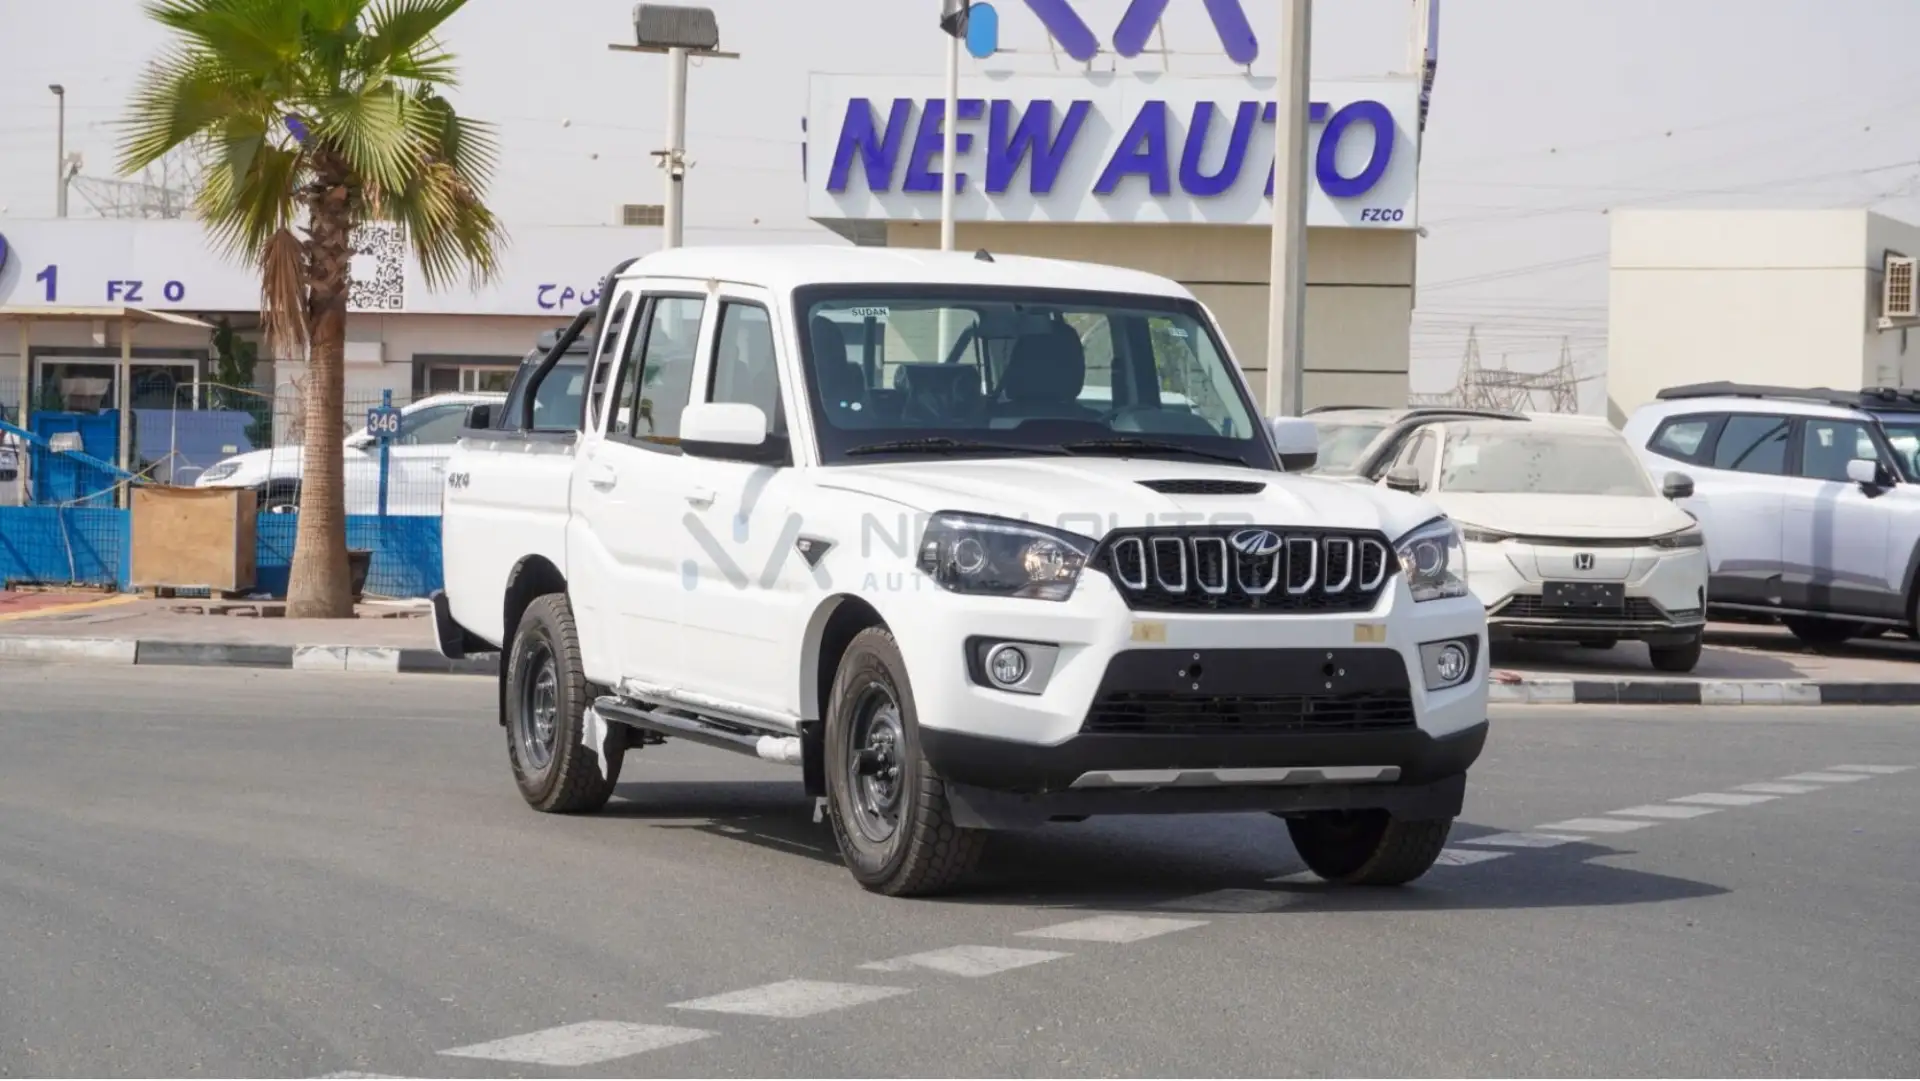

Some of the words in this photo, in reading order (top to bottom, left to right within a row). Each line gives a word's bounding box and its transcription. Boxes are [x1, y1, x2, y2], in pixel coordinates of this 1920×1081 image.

[826, 97, 1093, 195] NEW
[1092, 99, 1395, 199] AUO
[1360, 207, 1404, 222] FZCO
[851, 307, 888, 318] SUDAN
[369, 412, 398, 433] 346
